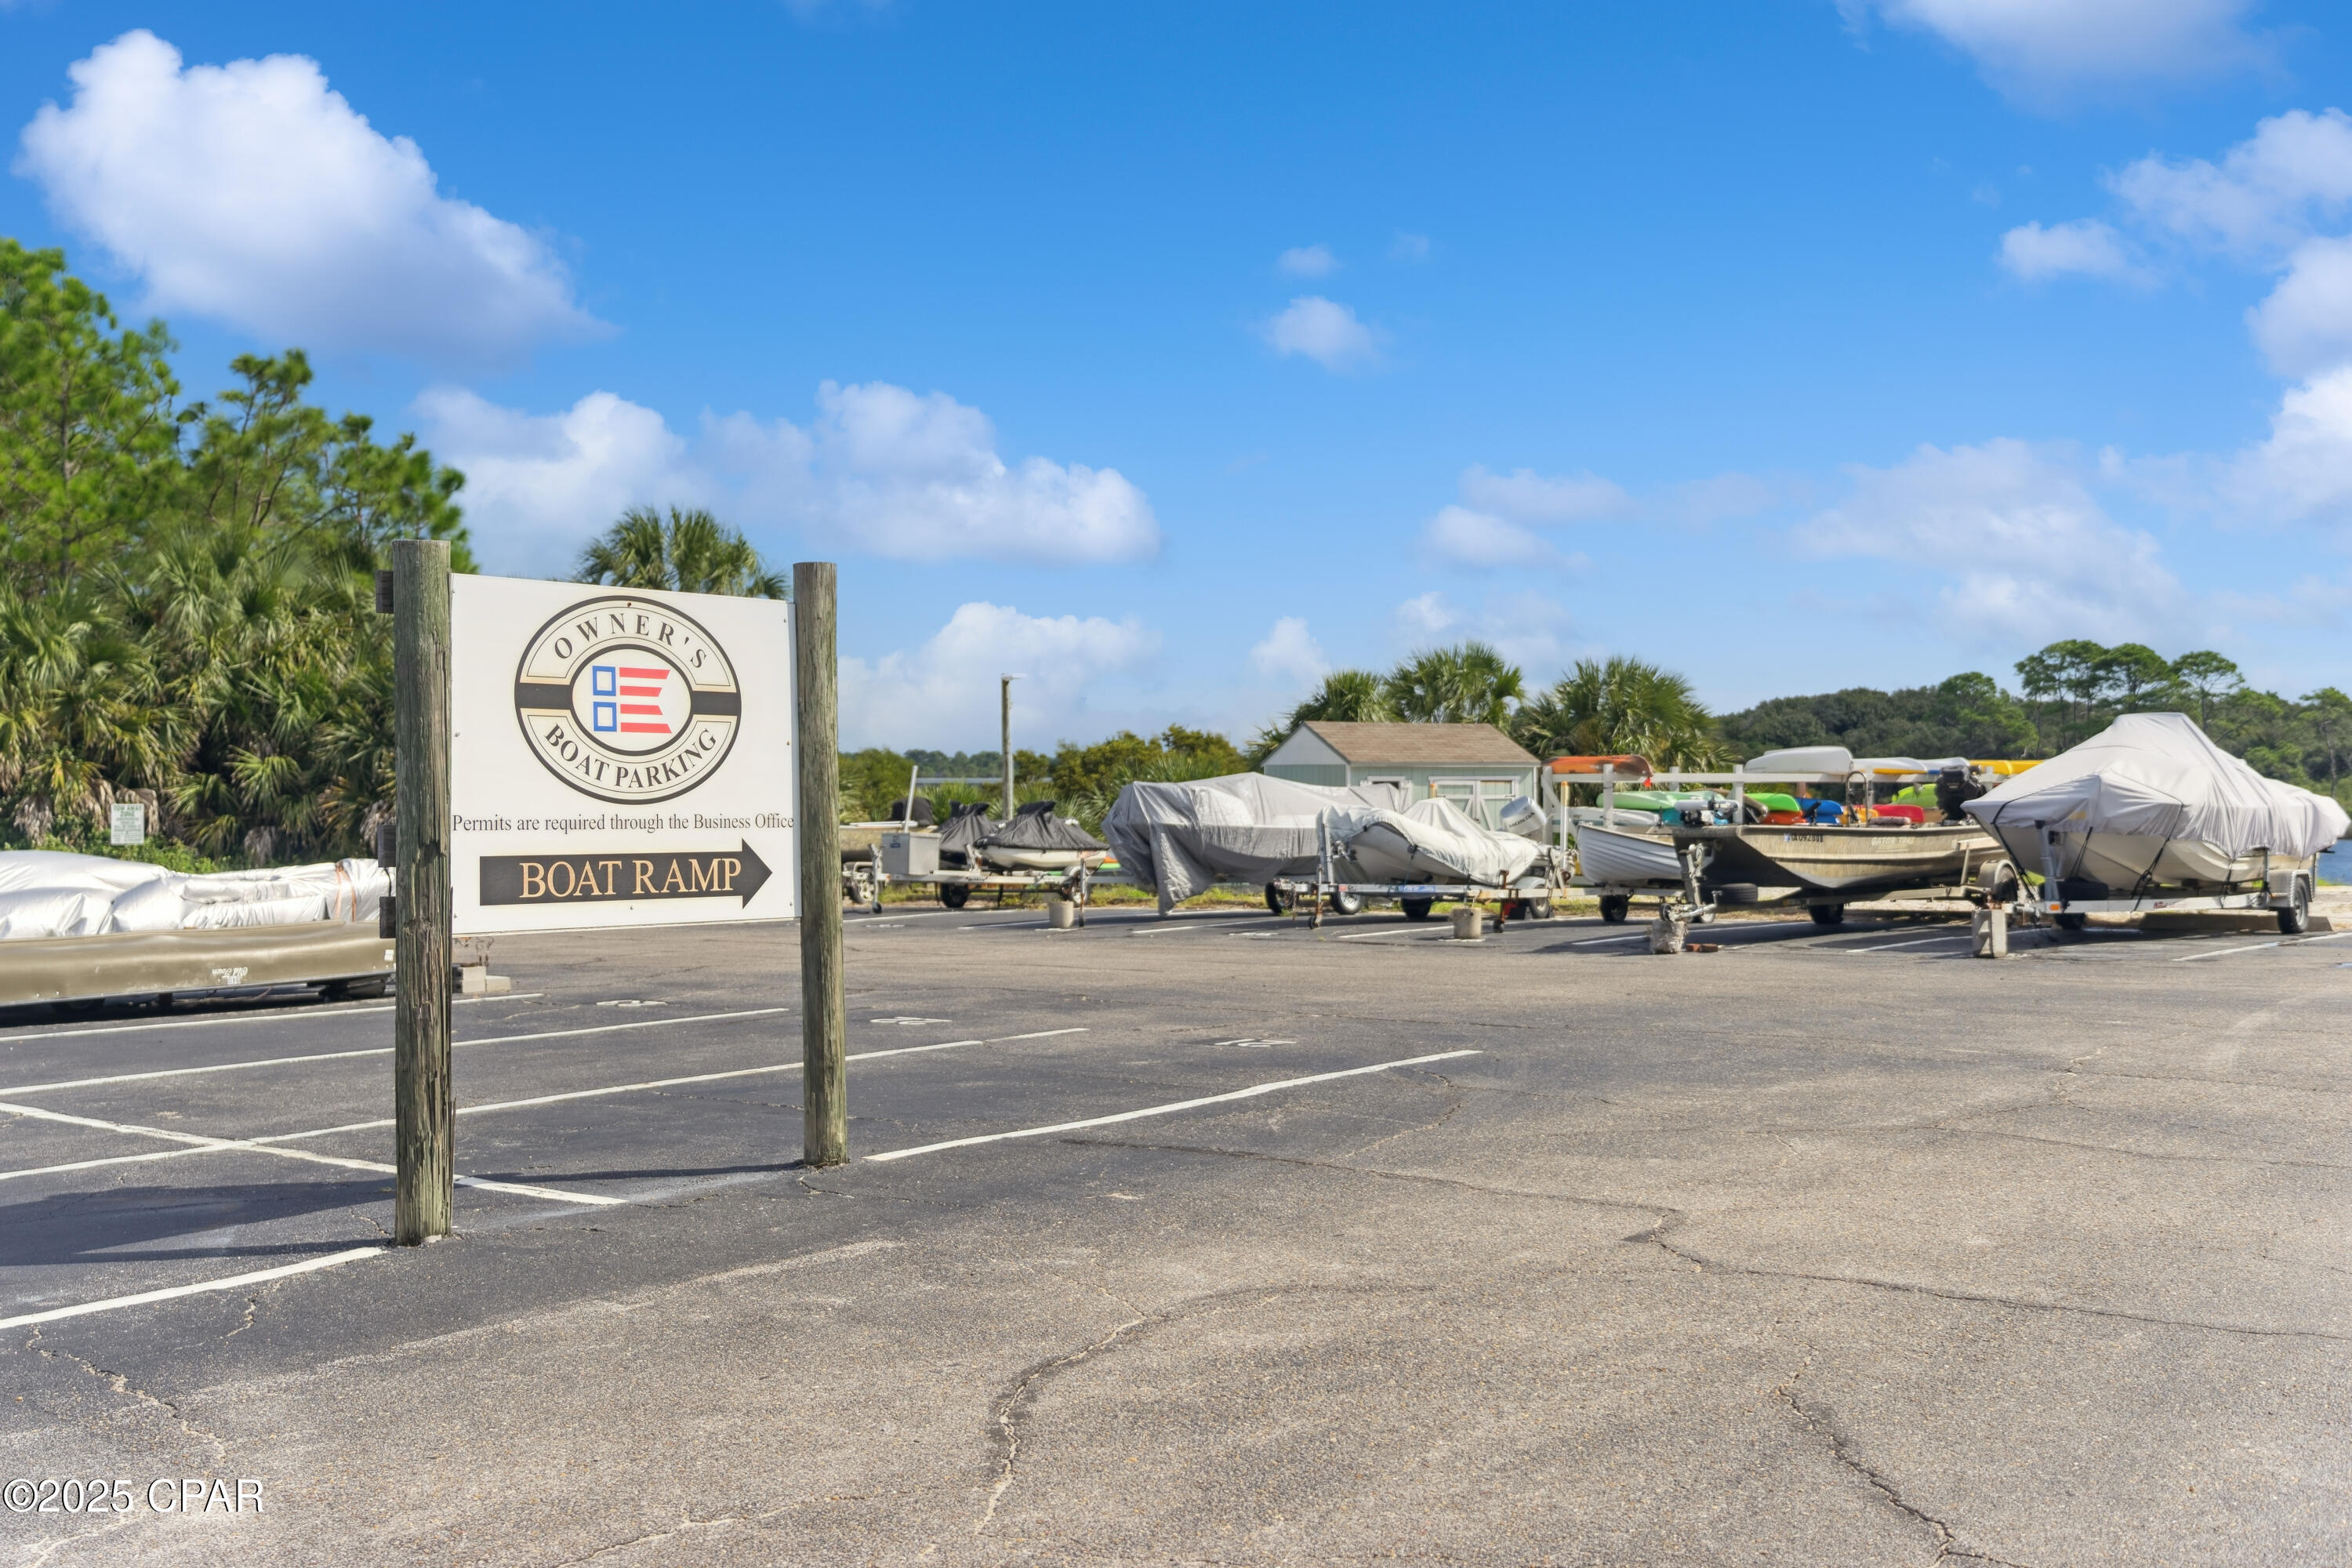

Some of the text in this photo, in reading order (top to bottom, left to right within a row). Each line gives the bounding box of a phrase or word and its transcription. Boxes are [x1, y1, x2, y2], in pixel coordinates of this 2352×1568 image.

[554, 613, 707, 669] OWNER'S
[545, 723, 717, 789] BOAT PARKING
[452, 812, 795, 834] Permits are required through the Business Office
[1508, 812, 1535, 828] HONDA
[519, 857, 742, 898] BOAT RAMP
